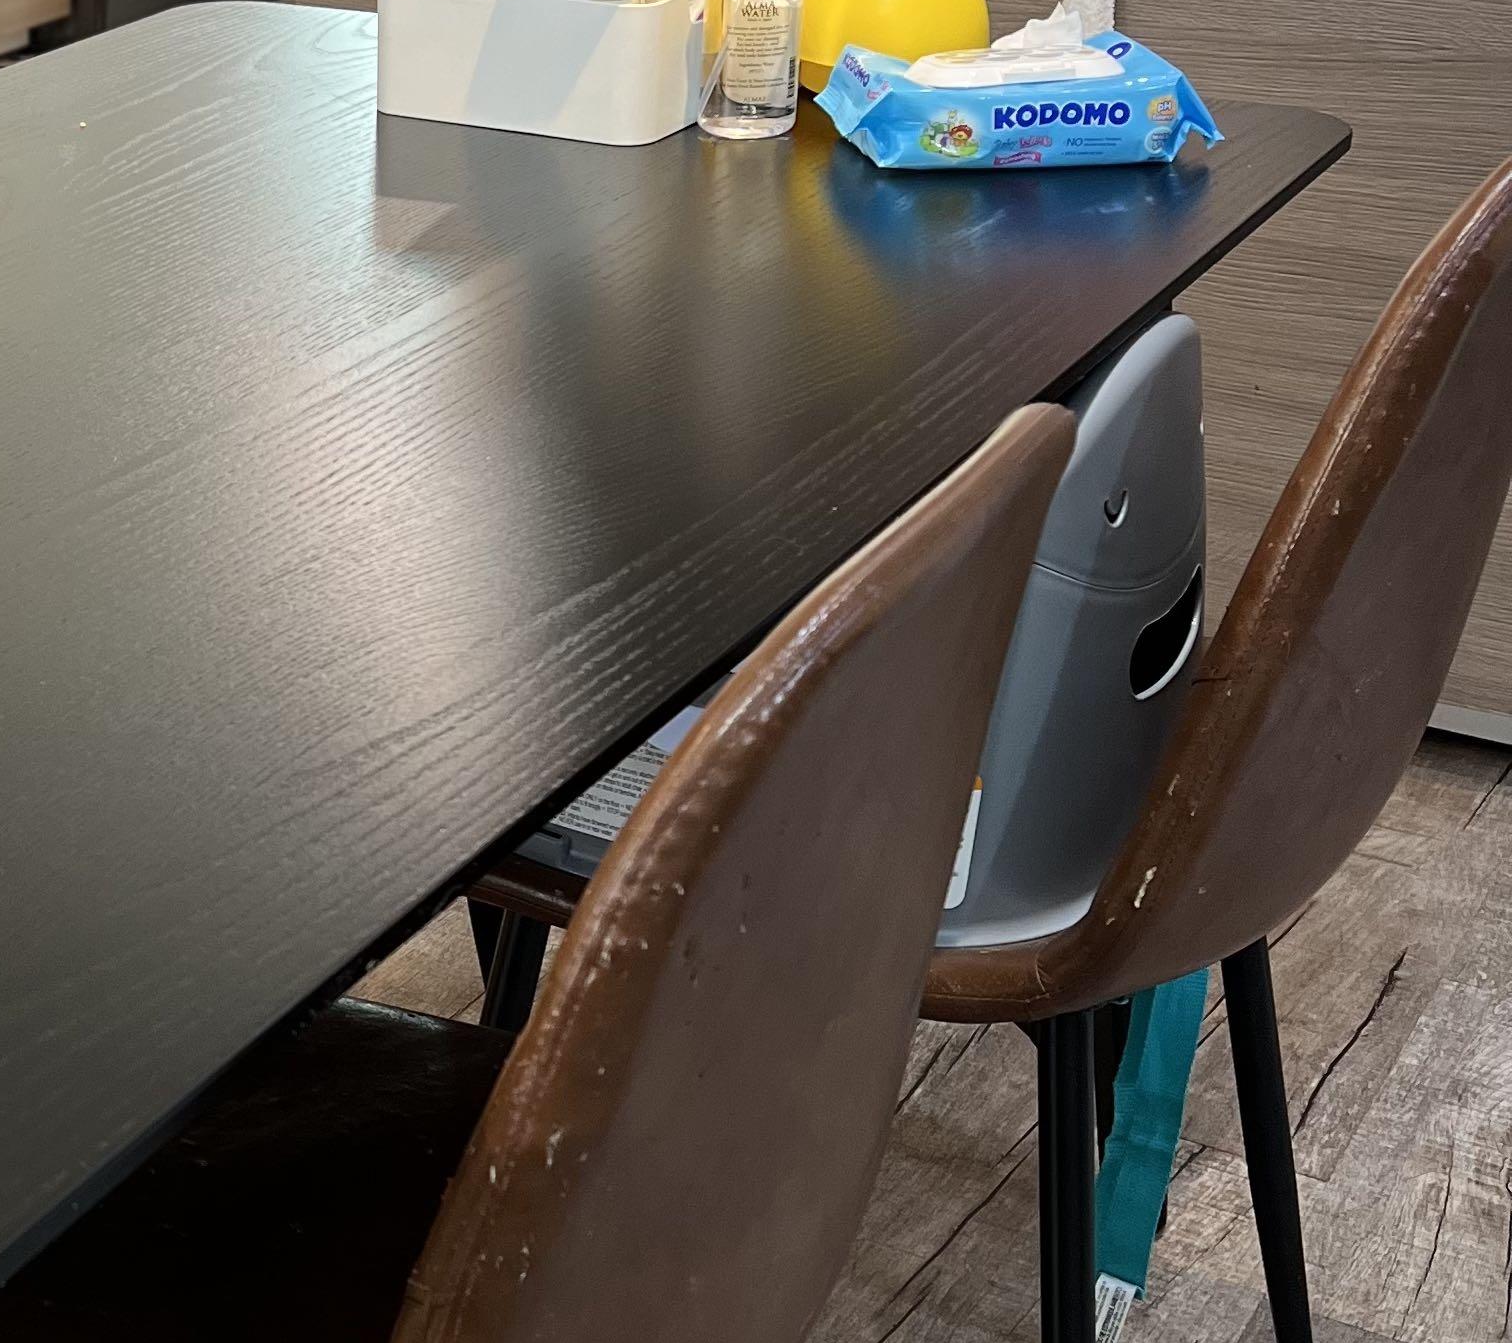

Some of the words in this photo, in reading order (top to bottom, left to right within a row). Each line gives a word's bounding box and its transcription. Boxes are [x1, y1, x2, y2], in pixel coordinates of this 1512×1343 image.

[745, 0, 775, 11] ALMA
[741, 7, 779, 18] WATER
[1157, 101, 1172, 113] pH
[994, 101, 1131, 129] KODOMO
[1066, 137, 1083, 147] NO
